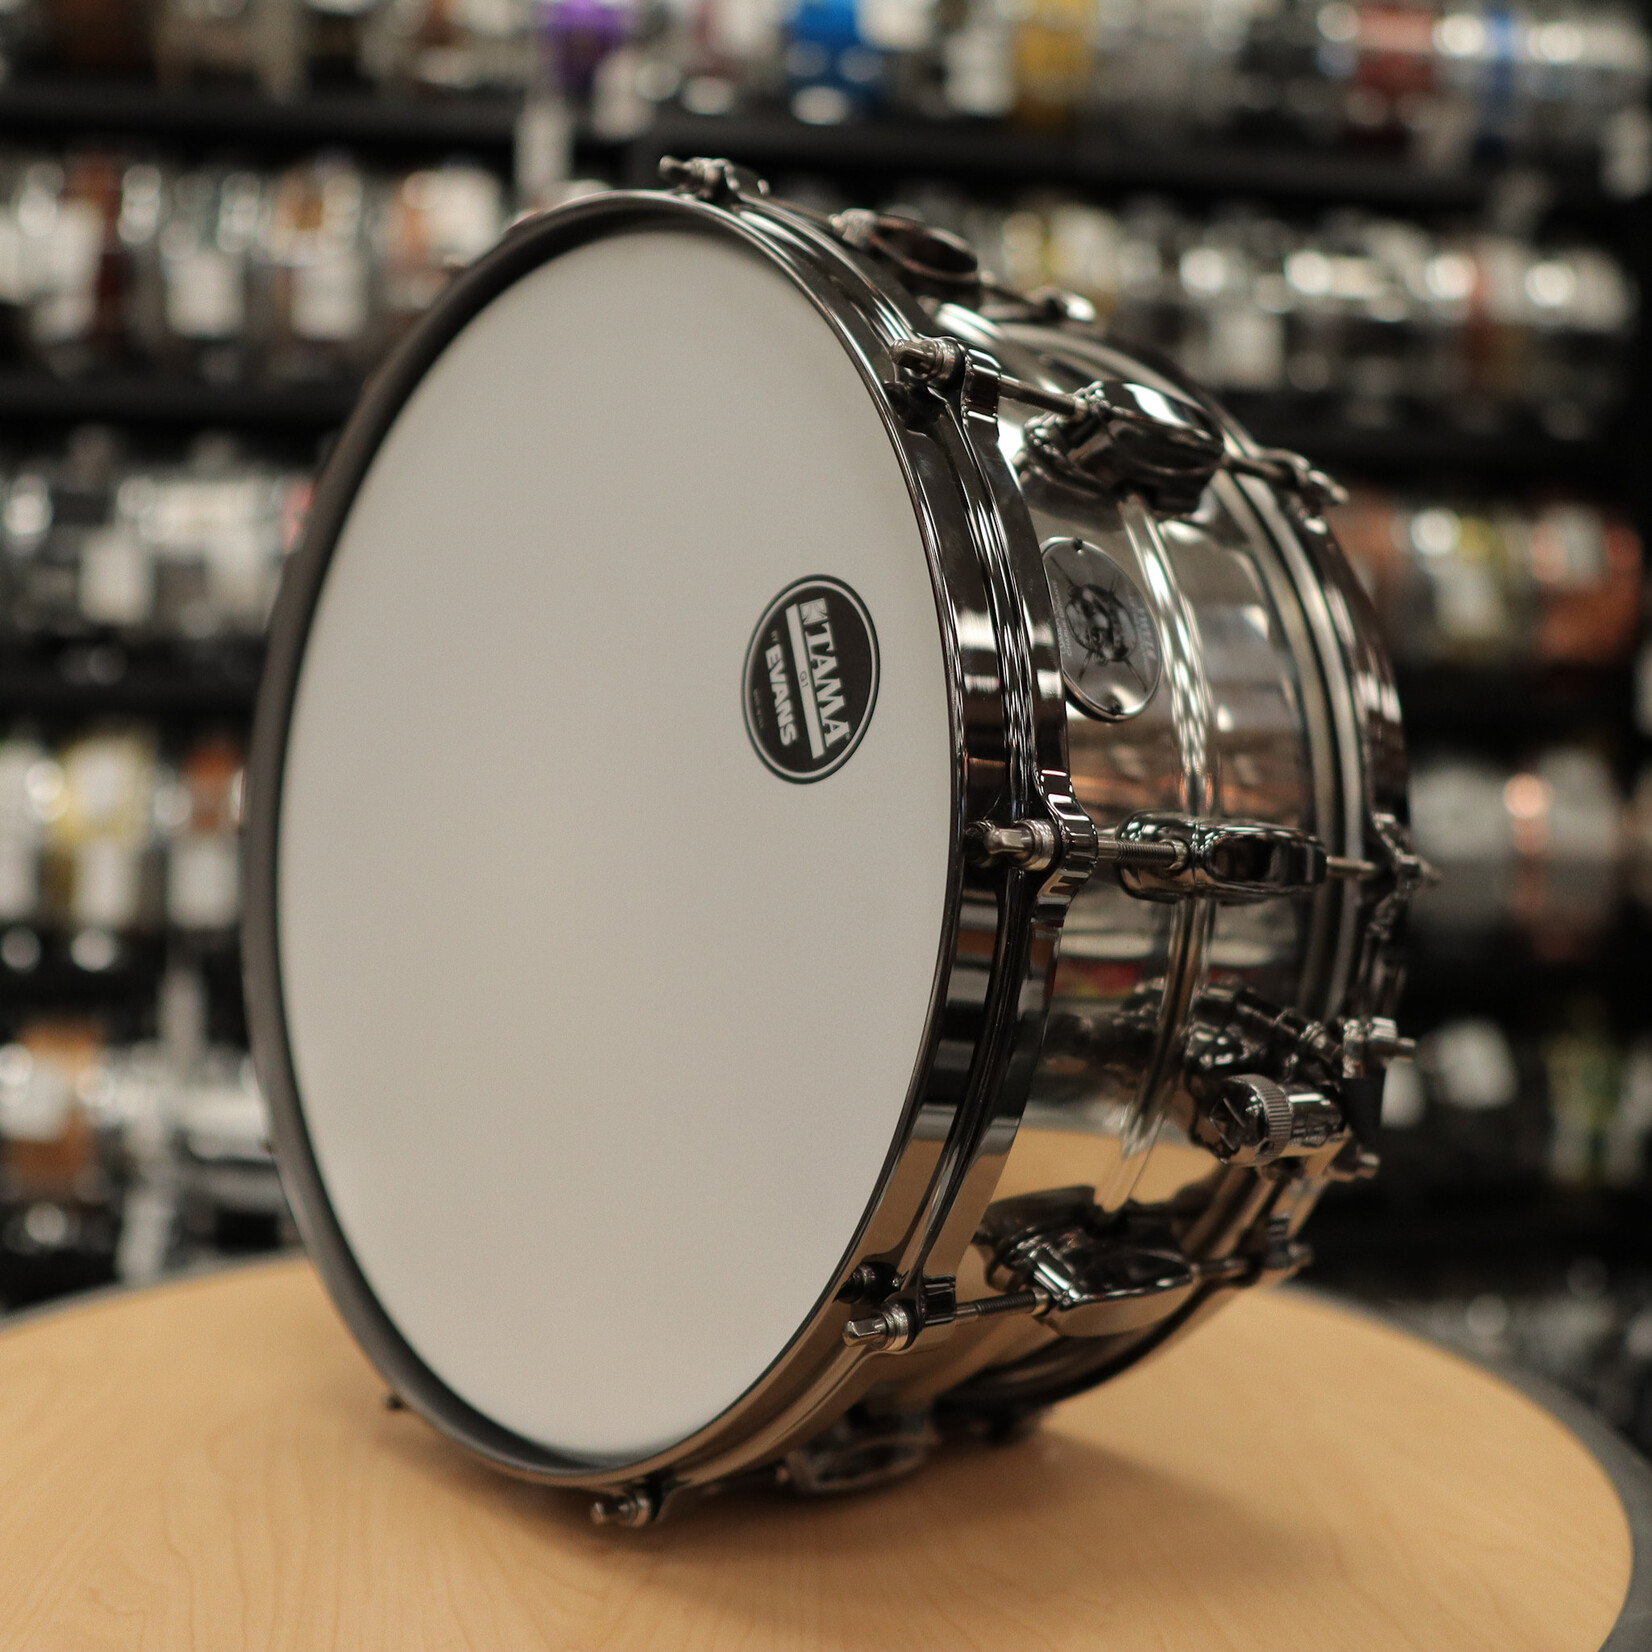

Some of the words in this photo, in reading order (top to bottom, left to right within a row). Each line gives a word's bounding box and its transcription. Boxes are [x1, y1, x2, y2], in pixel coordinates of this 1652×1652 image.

[765, 643, 797, 747] EVANS
[799, 670, 809, 688] G1
[805, 621, 851, 748] TAMA
